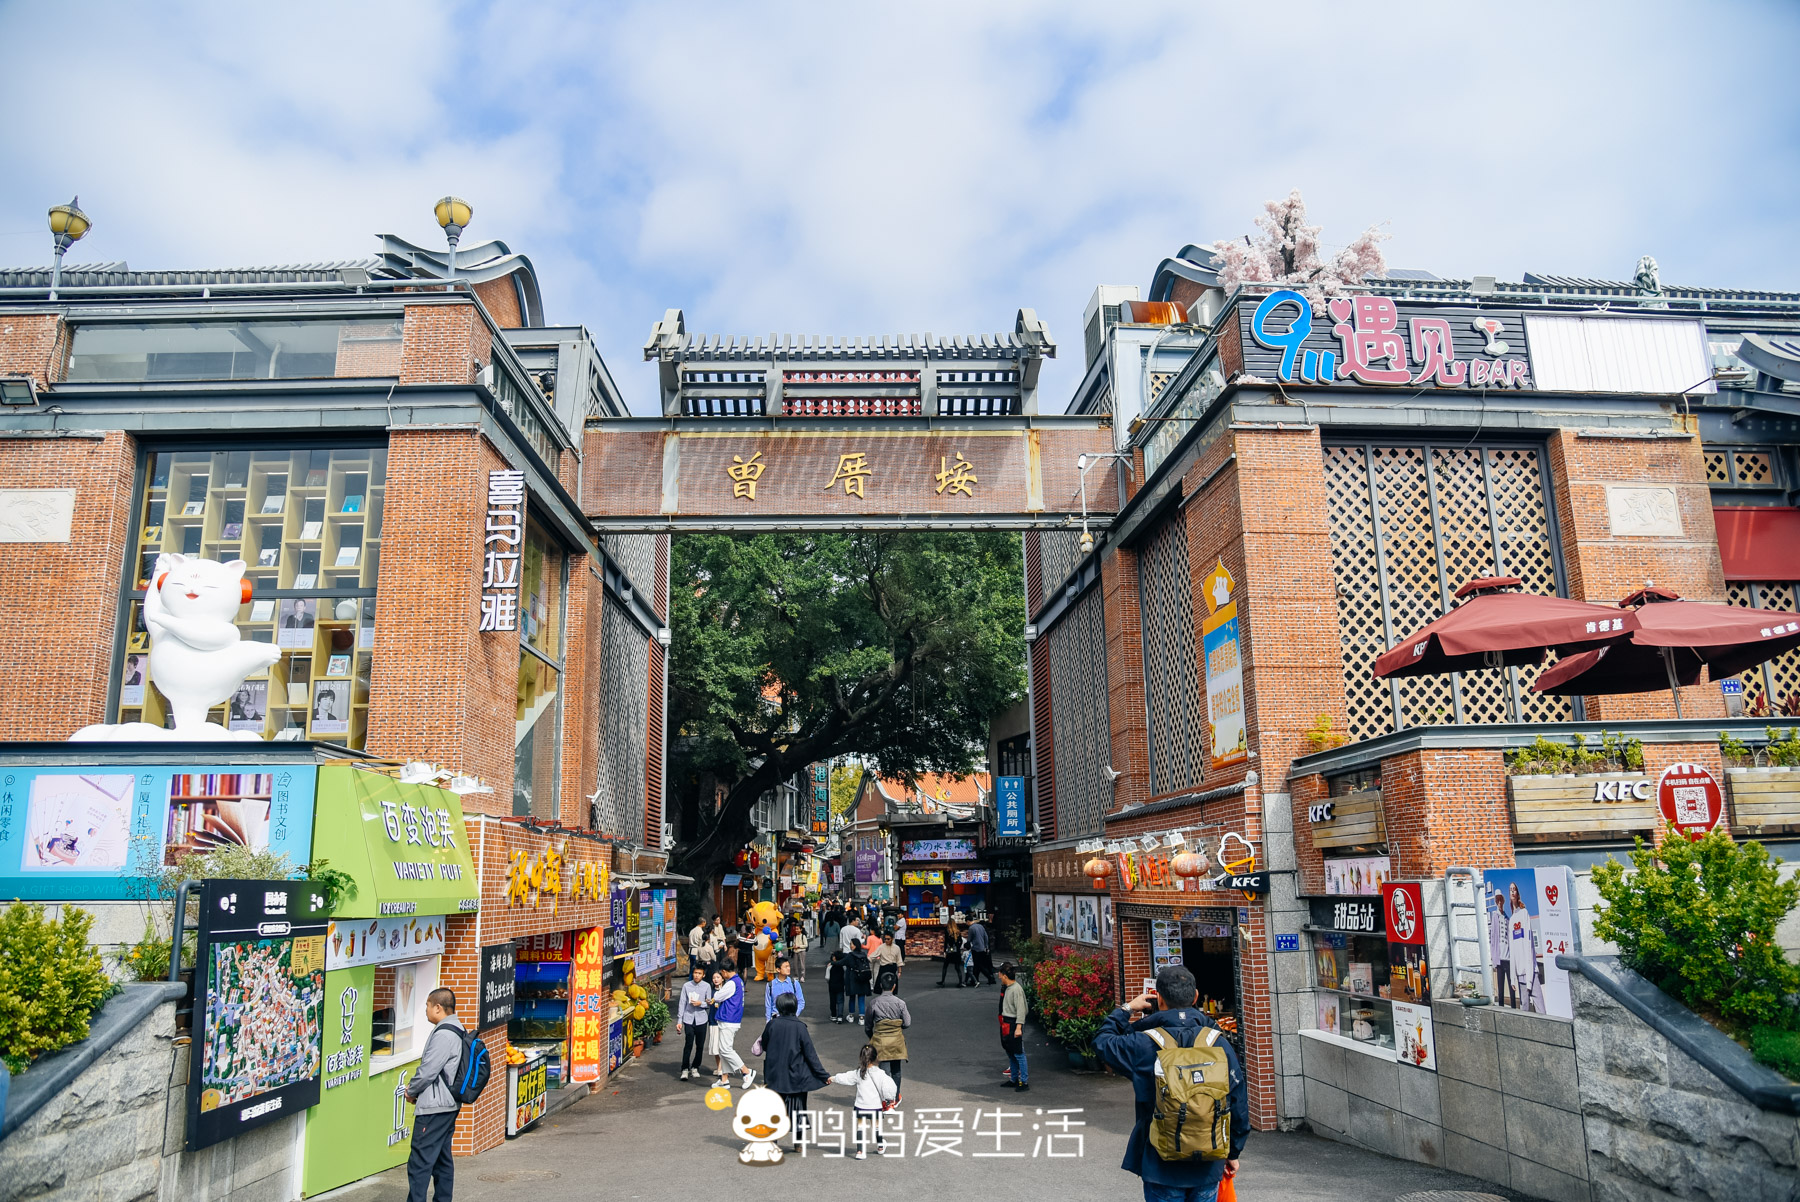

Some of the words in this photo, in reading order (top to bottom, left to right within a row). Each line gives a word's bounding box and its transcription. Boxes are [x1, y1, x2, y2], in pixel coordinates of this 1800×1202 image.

[1328, 295, 1467, 388] 遇见
[1470, 356, 1529, 388] BAR
[727, 450, 978, 500] 曾厝垵
[479, 469, 525, 631] 喜马拉雅
[1585, 617, 1623, 634] 肯德基
[1760, 622, 1799, 637] 肯德基
[1593, 779, 1651, 802] KFC
[0, 791, 14, 842] 休闲零食
[275, 790, 289, 841] 图书文创
[1006, 791, 1019, 828] 公共厕所
[1308, 803, 1333, 823] KFC
[379, 800, 456, 849] 百变泡芙
[393, 861, 435, 880] VARIETY
[438, 863, 463, 880] PUFF
[1231, 876, 1261, 887] KFC
[30, 886, 56, 895] GIFT
[58, 886, 90, 895] SHOP
[1334, 902, 1375, 931] 甜品站
[1405, 910, 1415, 918] KFC
[516, 950, 563, 962] 调料10元
[574, 969, 601, 991] 海鲜
[574, 992, 600, 1013] 任吃
[573, 1015, 600, 1038] 酒水
[326, 1045, 364, 1073] 百变泡芙
[572, 1039, 599, 1062] 任喝
[517, 1063, 547, 1107] 蚵仔煎
